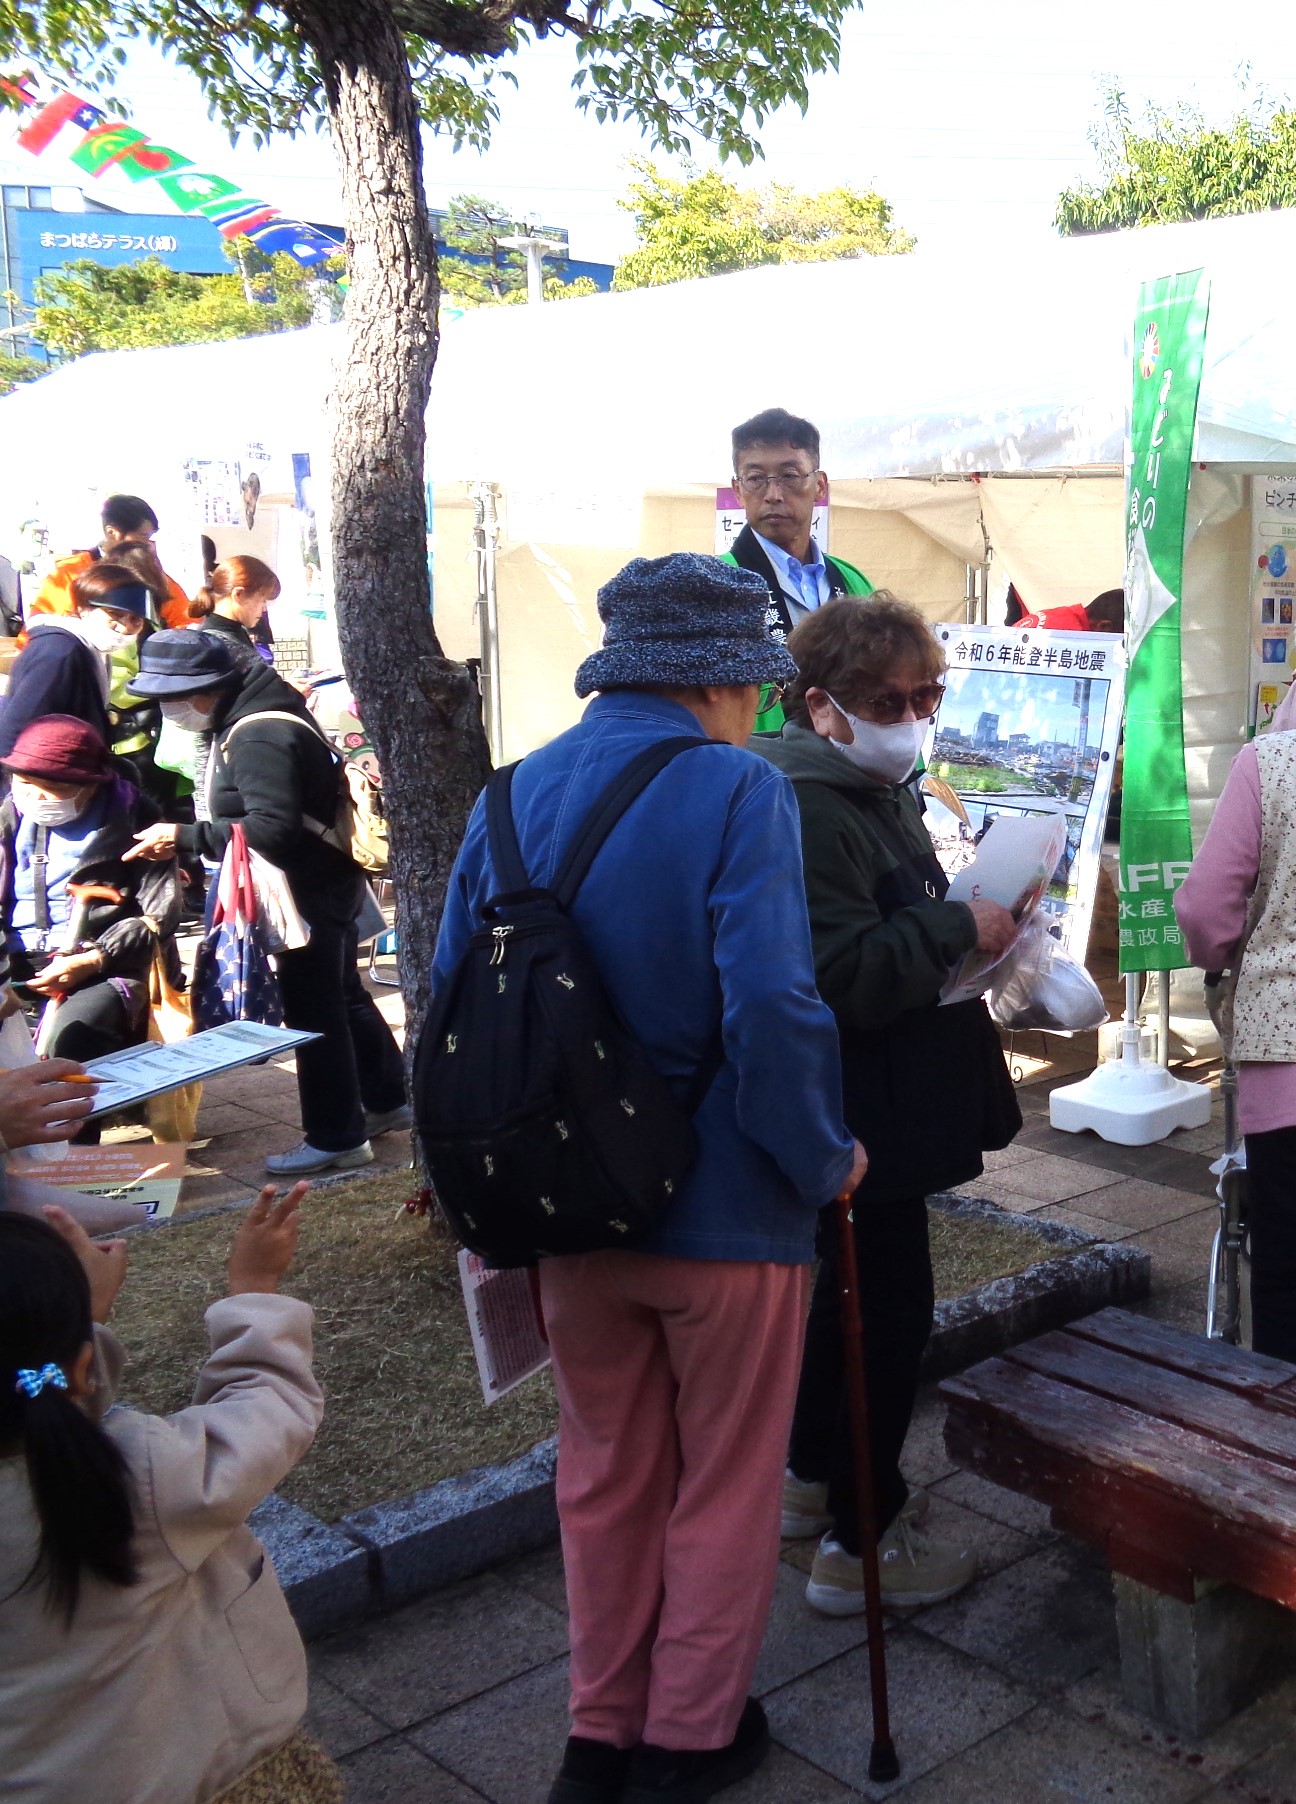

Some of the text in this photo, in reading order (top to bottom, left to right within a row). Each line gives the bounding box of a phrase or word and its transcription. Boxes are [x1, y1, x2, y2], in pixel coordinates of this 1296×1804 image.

[955, 641, 1106, 672] 令和6年能登半島地震
[1119, 899, 1174, 919] 水産
